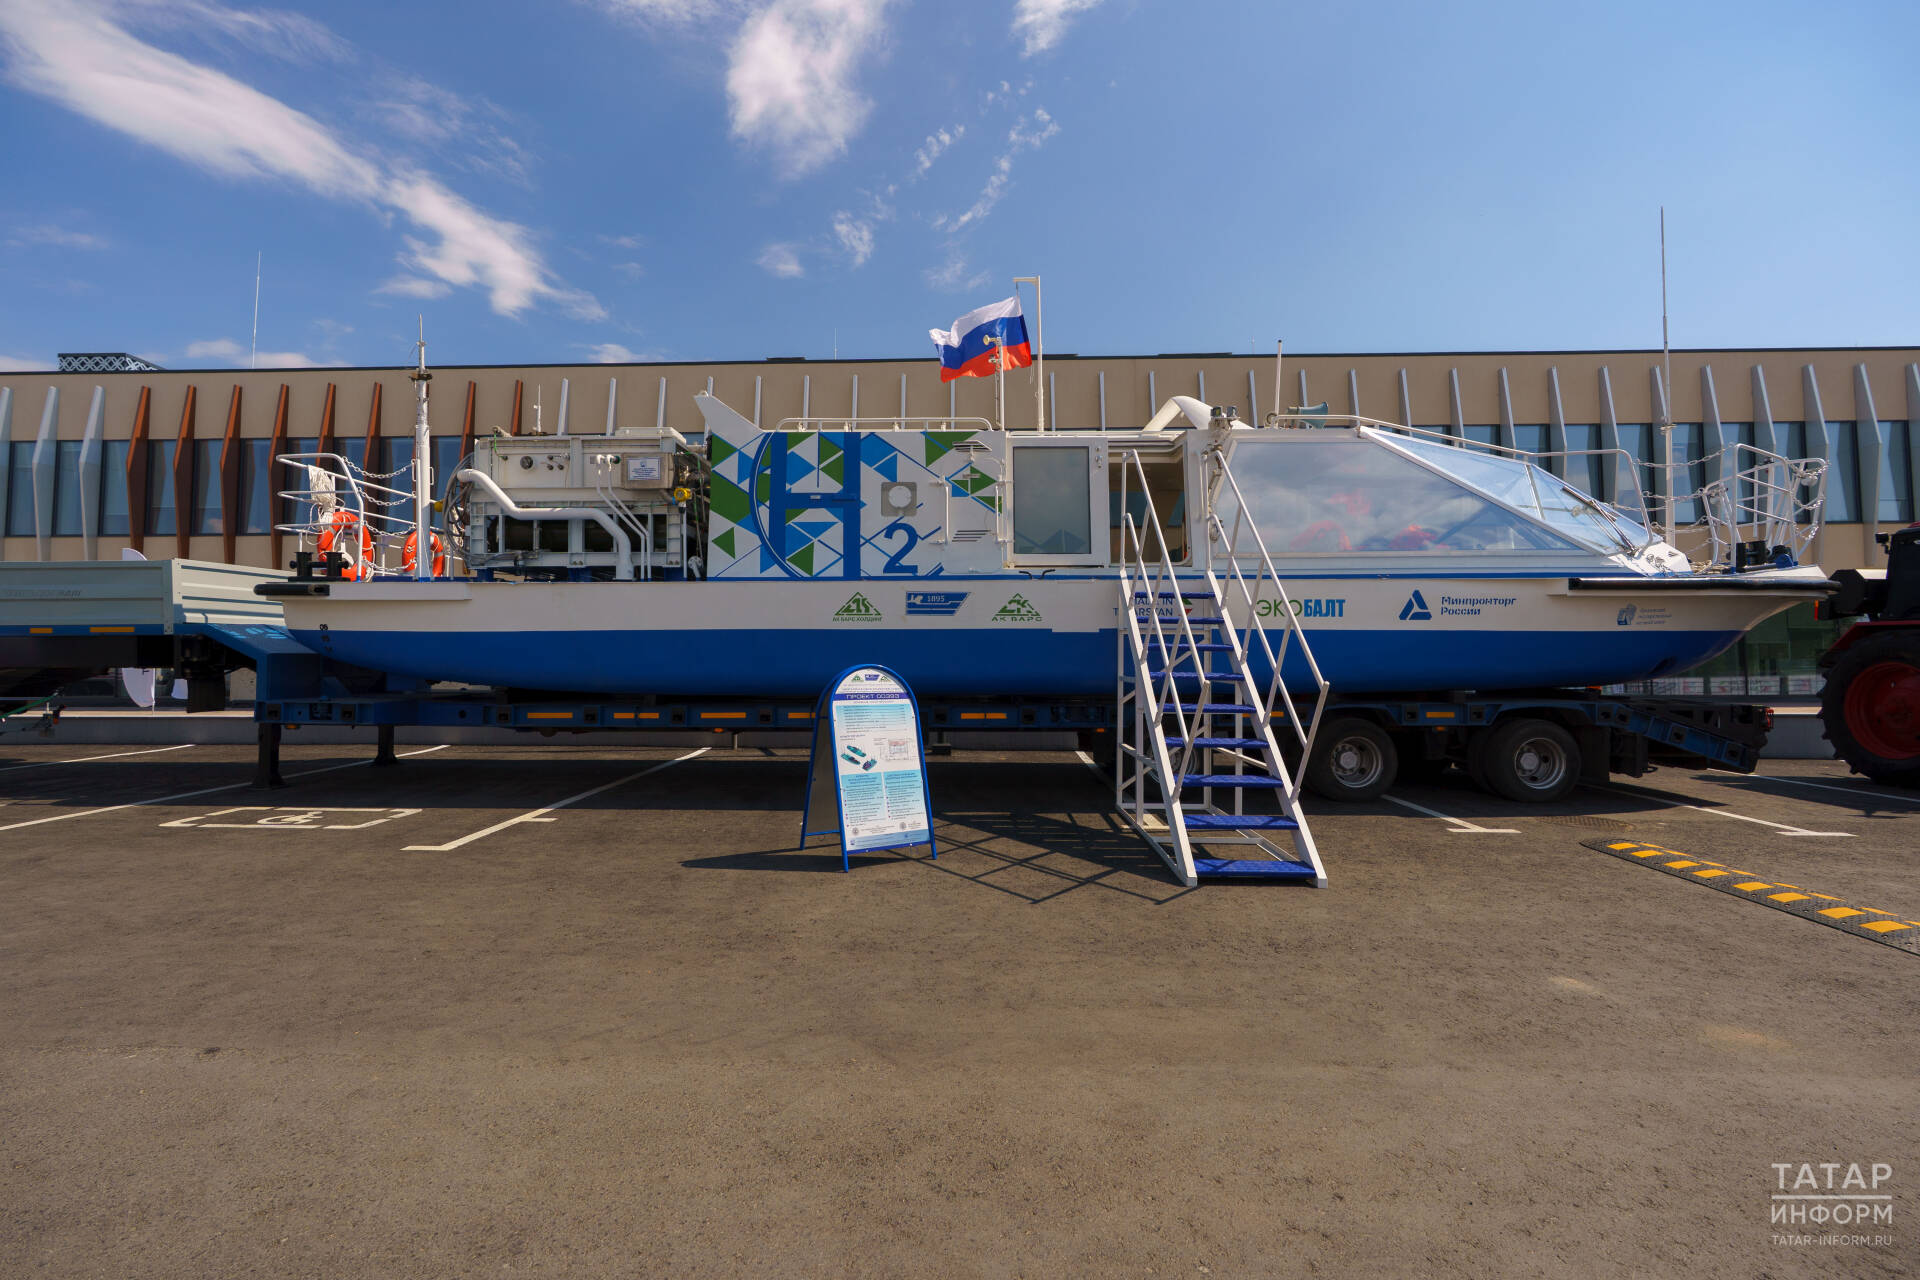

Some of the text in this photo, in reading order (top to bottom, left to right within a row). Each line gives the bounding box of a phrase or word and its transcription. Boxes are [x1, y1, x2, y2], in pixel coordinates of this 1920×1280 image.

[1441, 596, 1517, 607] Минпромторг
[1113, 607, 1173, 617] TRSAN
[1440, 606, 1481, 616] России
